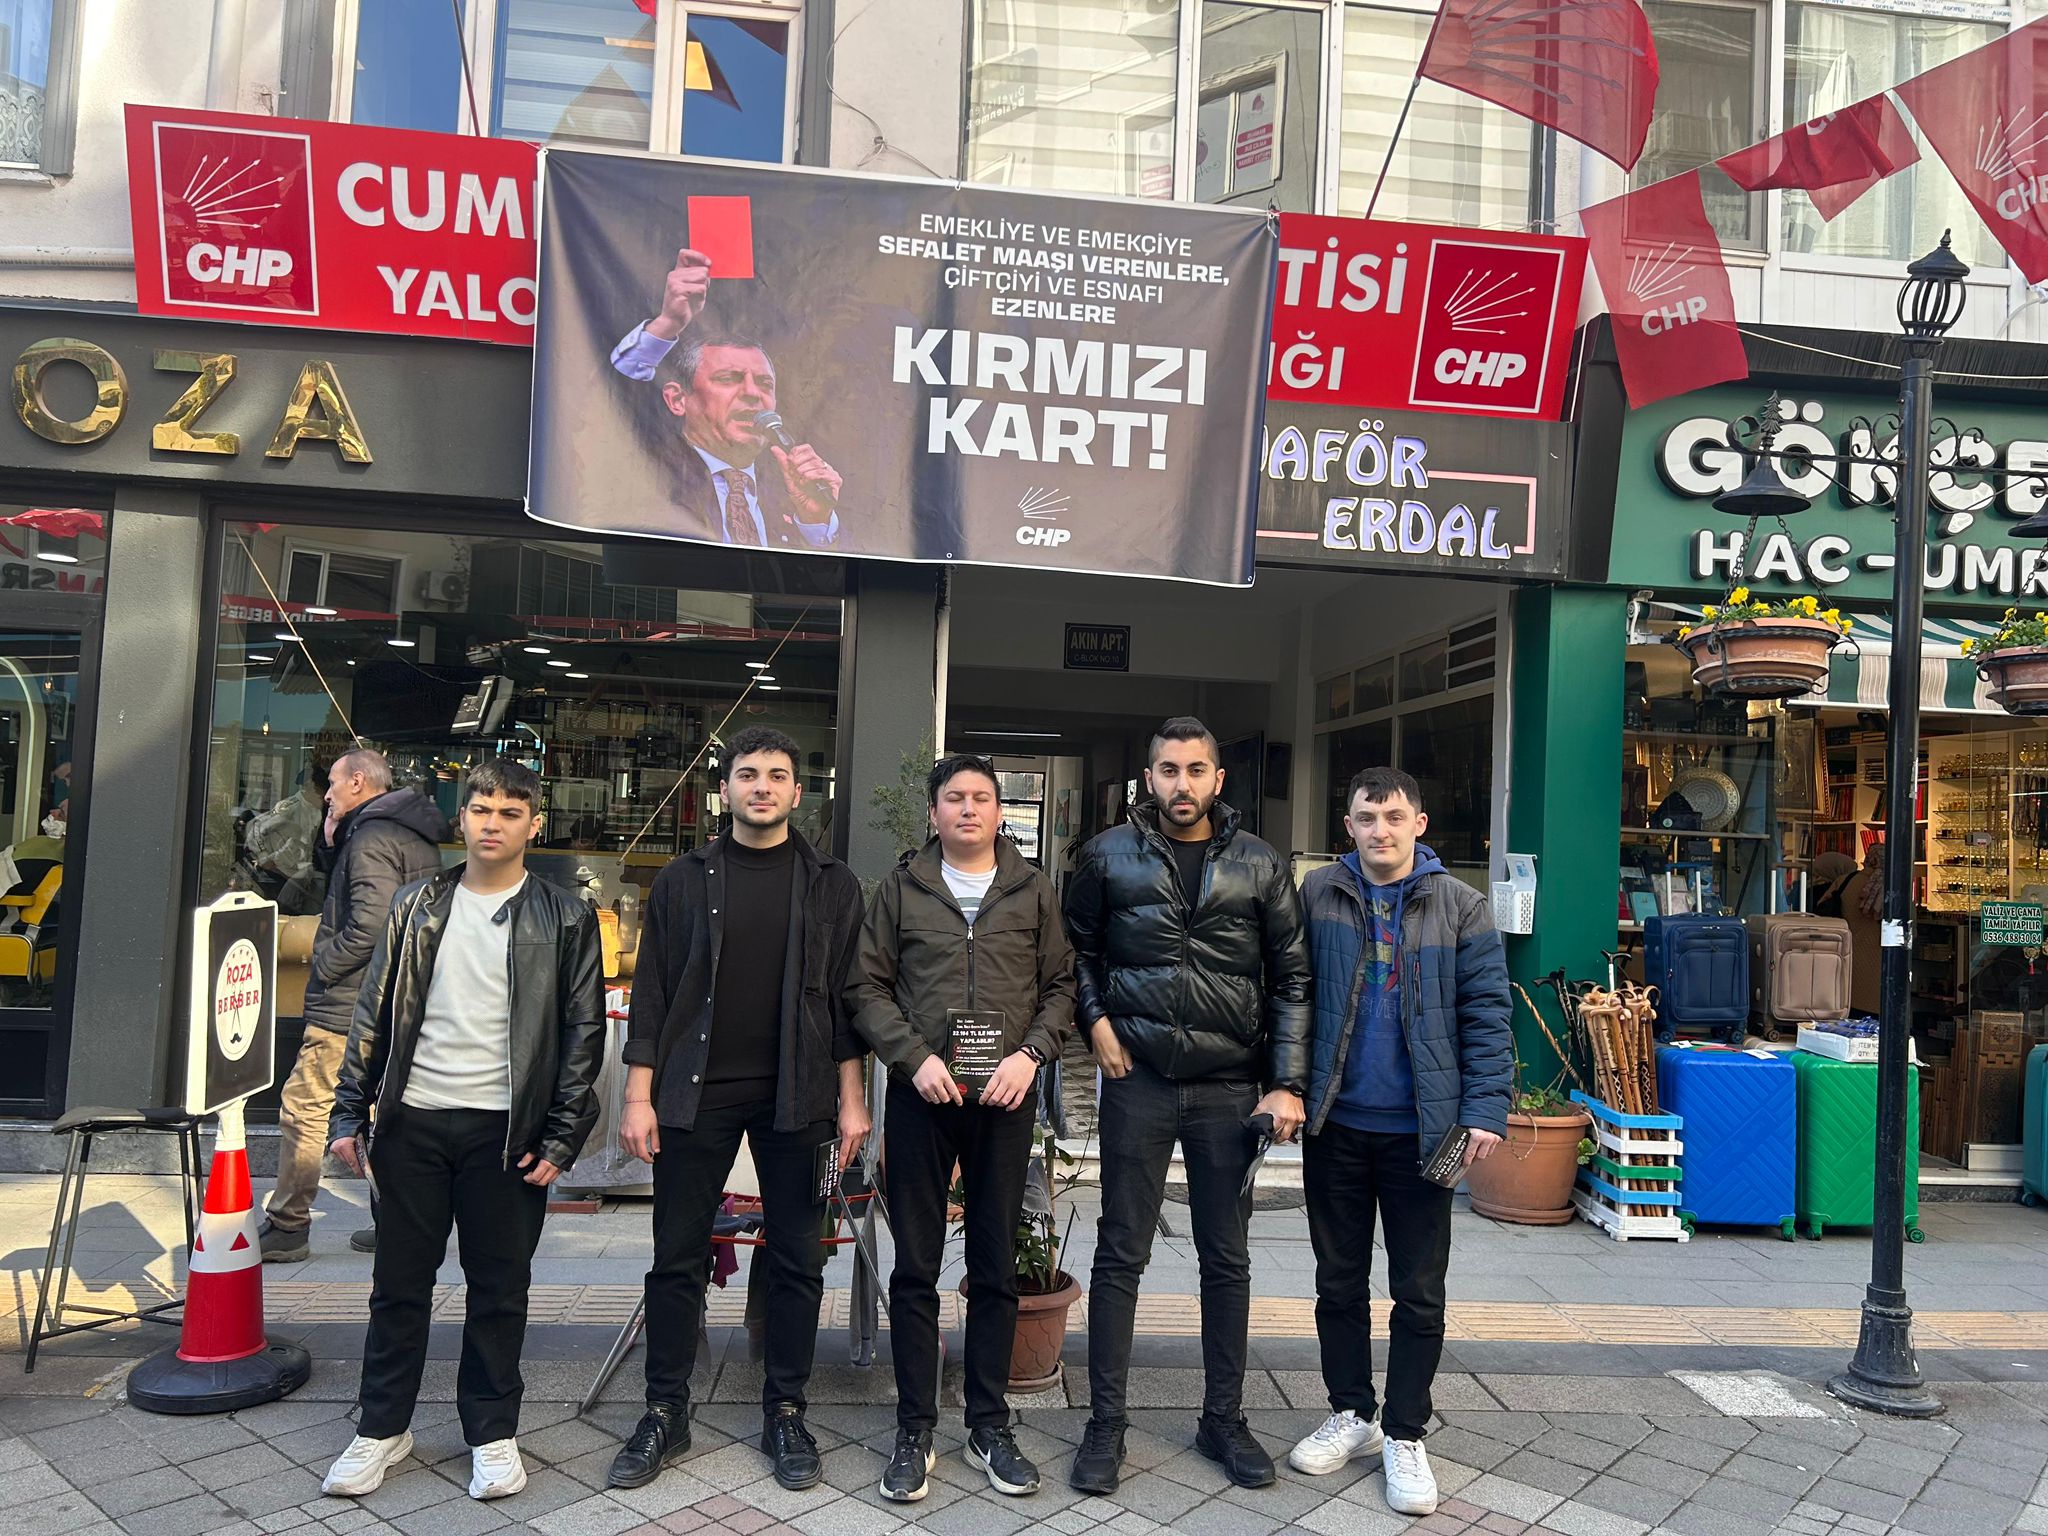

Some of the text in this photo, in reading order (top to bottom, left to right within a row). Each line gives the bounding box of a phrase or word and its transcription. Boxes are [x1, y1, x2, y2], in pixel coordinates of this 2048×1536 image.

[336, 161, 538, 241] CUM
[919, 213, 1192, 257] EMEKLİYE VE EMEKÇİYE
[186, 243, 293, 288] CHP
[878, 235, 1230, 286] SEFALET MAAŞI VERENLERE,
[944, 266, 1163, 304] ÇİFTÇİYİ VE ESNAFI
[991, 297, 1116, 325] EZENLERE
[1640, 295, 1708, 338] CHP
[893, 325, 1208, 406] KIRMIZI
[1434, 348, 1527, 388] CHP
[11, 336, 373, 465] OZA
[928, 397, 1169, 471] KART!
[1260, 418, 1429, 489] AFÖR
[1015, 526, 1071, 547] CHP
[1322, 496, 1511, 559] ERDAL
[1070, 631, 1098, 650] AKIN
[1983, 904, 2042, 920] VALİZ VE ÇANTA
[2012, 919, 2041, 931] YAPILIR
[1983, 931, 2003, 942] 0536
[2020, 933, 2030, 943] 30
[226, 962, 253, 985] ROZA
[217, 989, 260, 1016] BERBER
